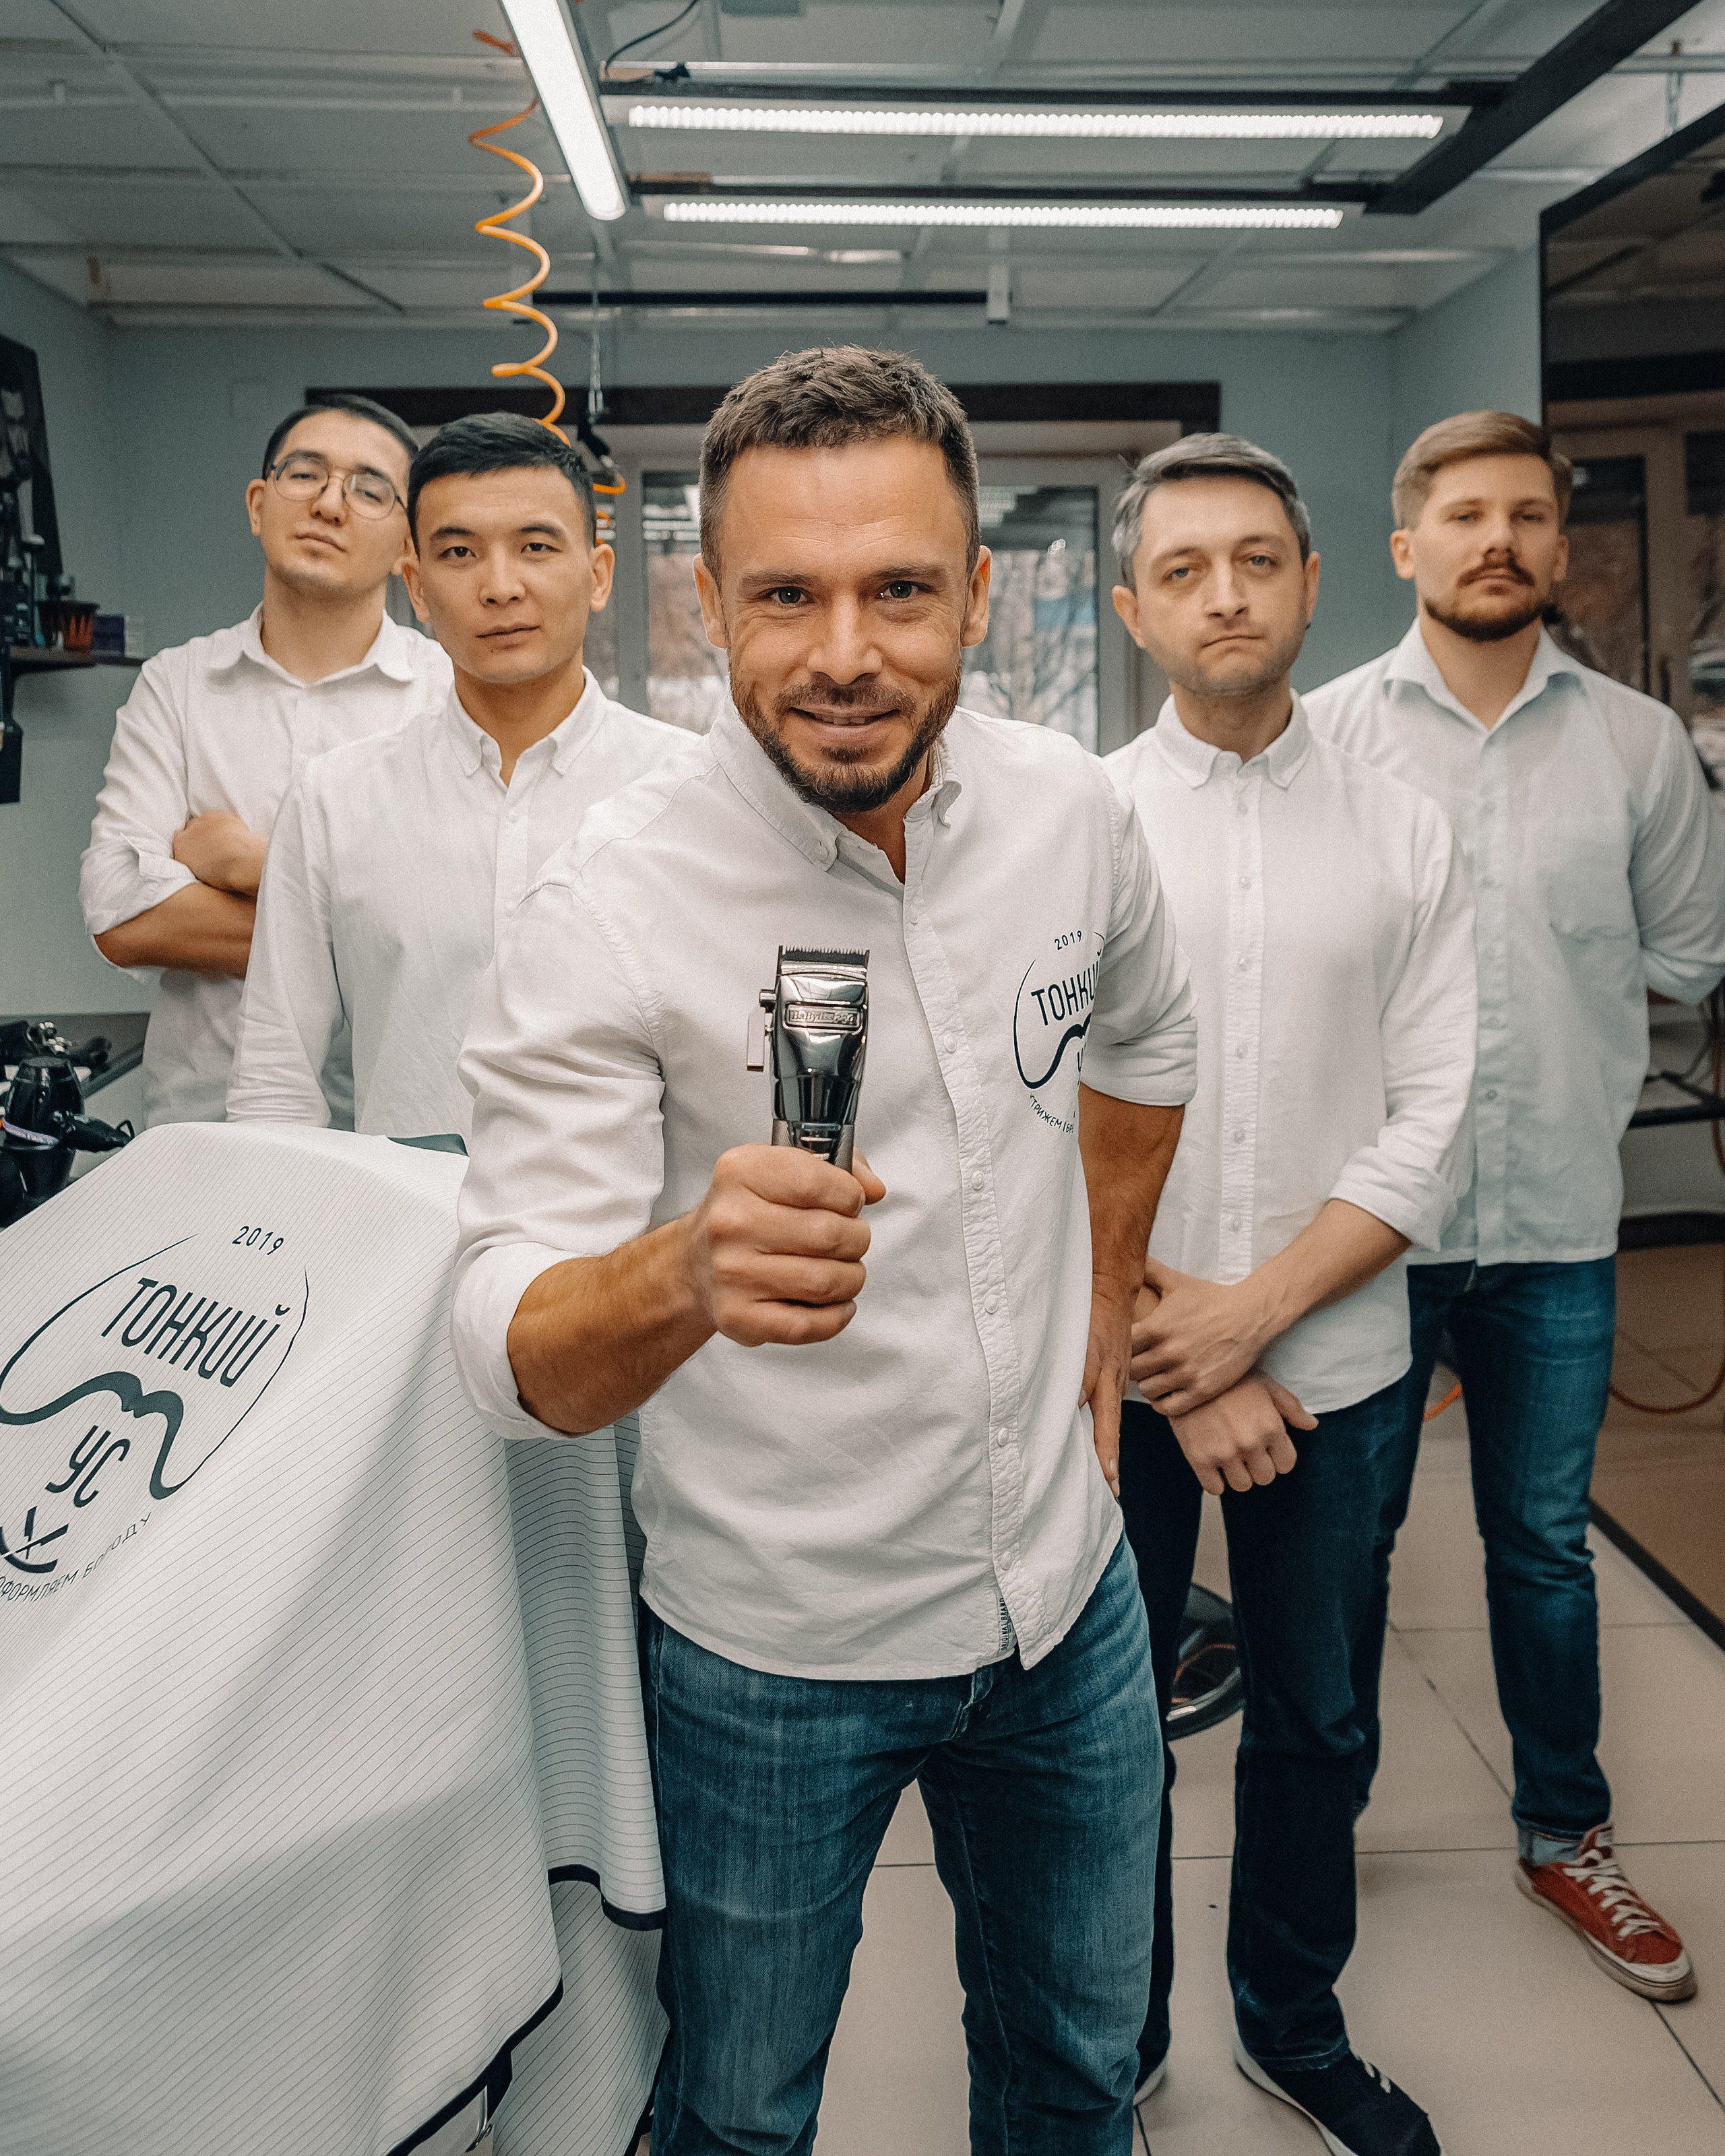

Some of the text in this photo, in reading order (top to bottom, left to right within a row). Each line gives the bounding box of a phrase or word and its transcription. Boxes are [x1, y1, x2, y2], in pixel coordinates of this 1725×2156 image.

[1054, 930, 1082, 951] 2019
[232, 1226, 284, 1255] 2019
[101, 1277, 290, 1387] ТОНКИЙ
[44, 1425, 131, 1508] УС
[82, 1511, 152, 1579] БООДУ
